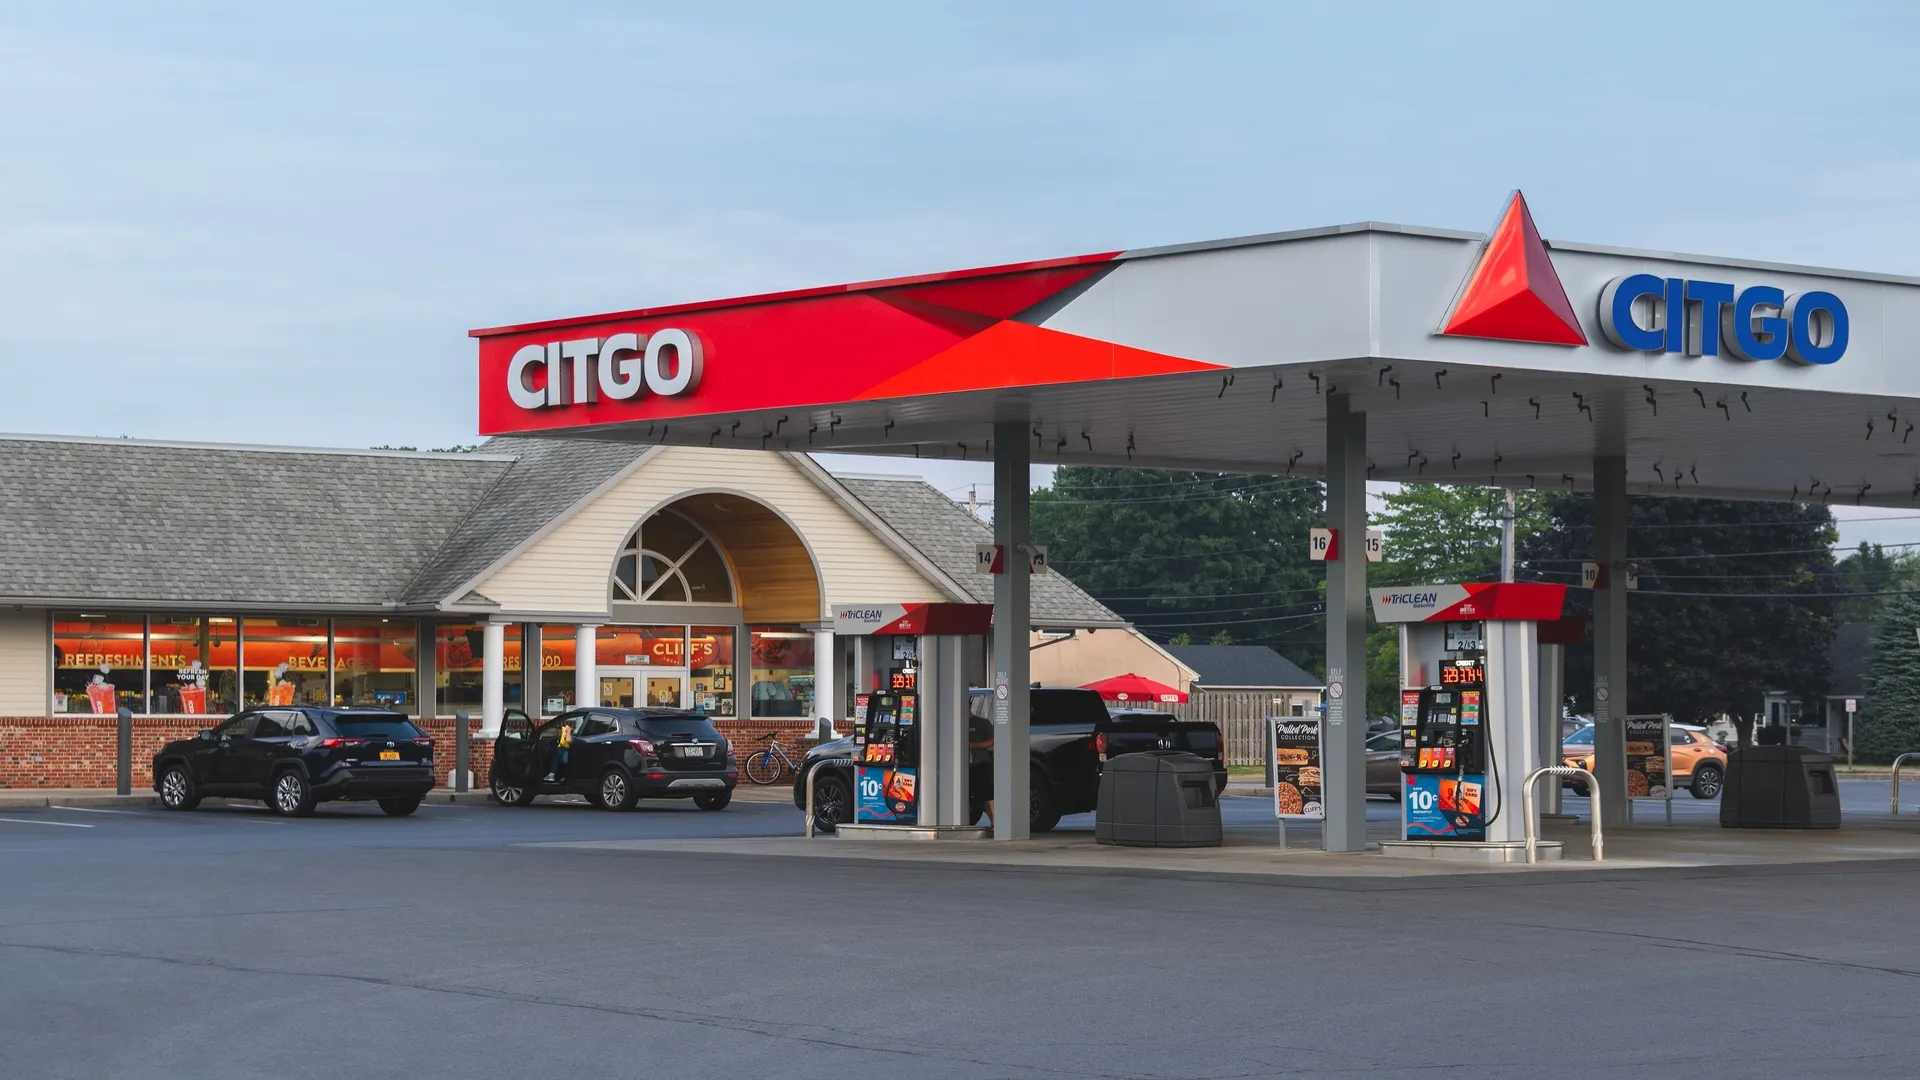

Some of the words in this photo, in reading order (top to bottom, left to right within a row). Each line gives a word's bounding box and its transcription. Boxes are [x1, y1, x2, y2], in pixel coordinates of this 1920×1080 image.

[1601, 274, 1849, 365] CITGO
[507, 328, 702, 409] CITGO
[1313, 537, 1326, 550] 16
[1366, 538, 1379, 551] 15
[978, 552, 991, 564] 14
[1584, 569, 1596, 581] 10
[1391, 593, 1437, 604] TriCLEAN
[64, 653, 186, 667] REFRESHMENTS
[288, 656, 373, 668] BEVEAGES
[1277, 724, 1301, 735] Pulled
[1301, 724, 1318, 735] Pork
